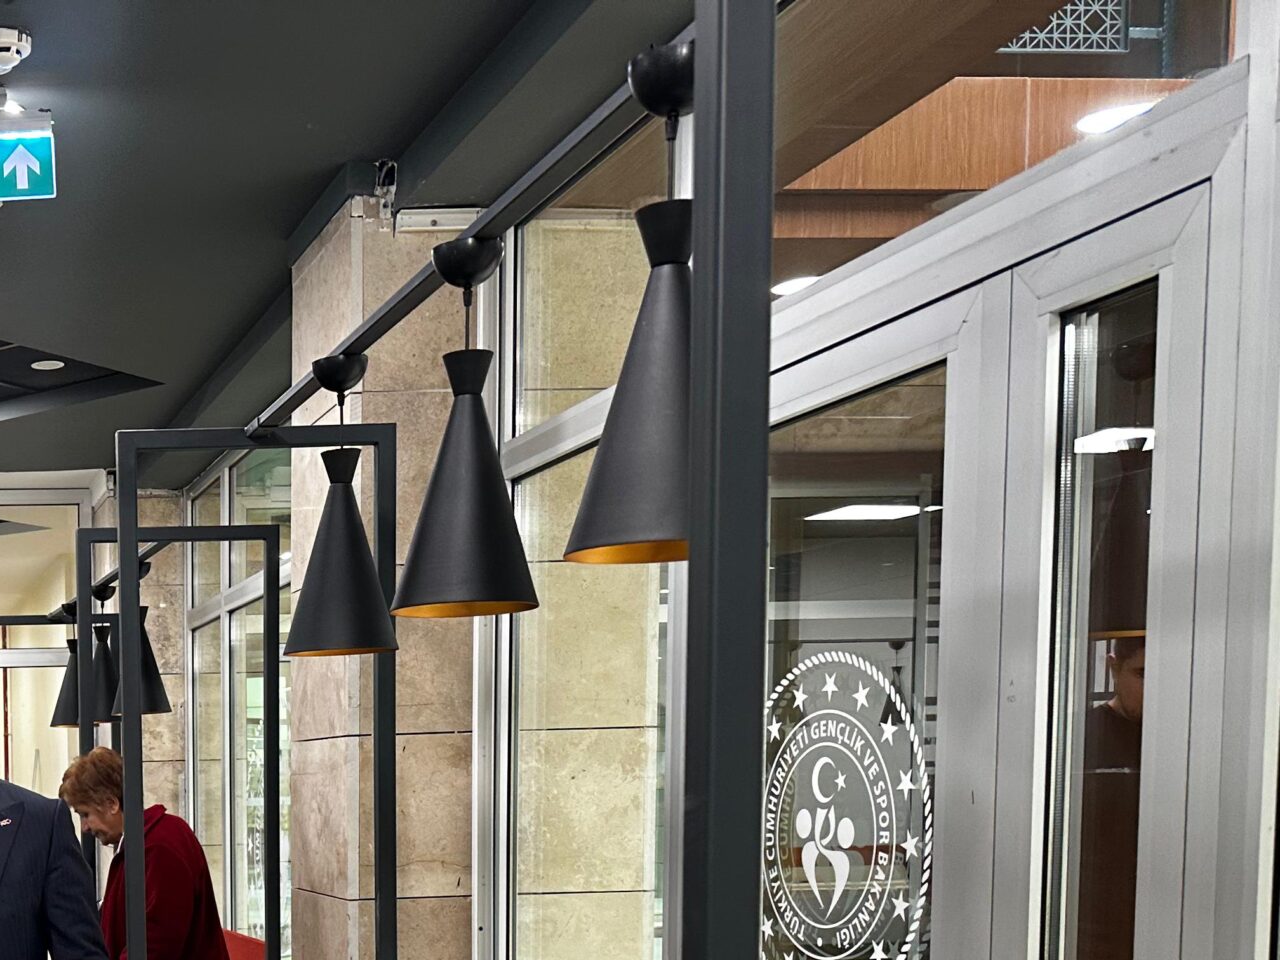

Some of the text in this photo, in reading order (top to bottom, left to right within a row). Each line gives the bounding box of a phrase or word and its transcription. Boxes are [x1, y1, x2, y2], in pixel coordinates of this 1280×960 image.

[810, 719, 866, 756] GENÇLİK
[863, 748, 880, 780] VE
[765, 725, 809, 860] CUMHURİYETİ
[873, 780, 890, 844] SPOR
[768, 866, 806, 942] TÜRKİYE
[837, 851, 889, 949] BAKANLIĞI
